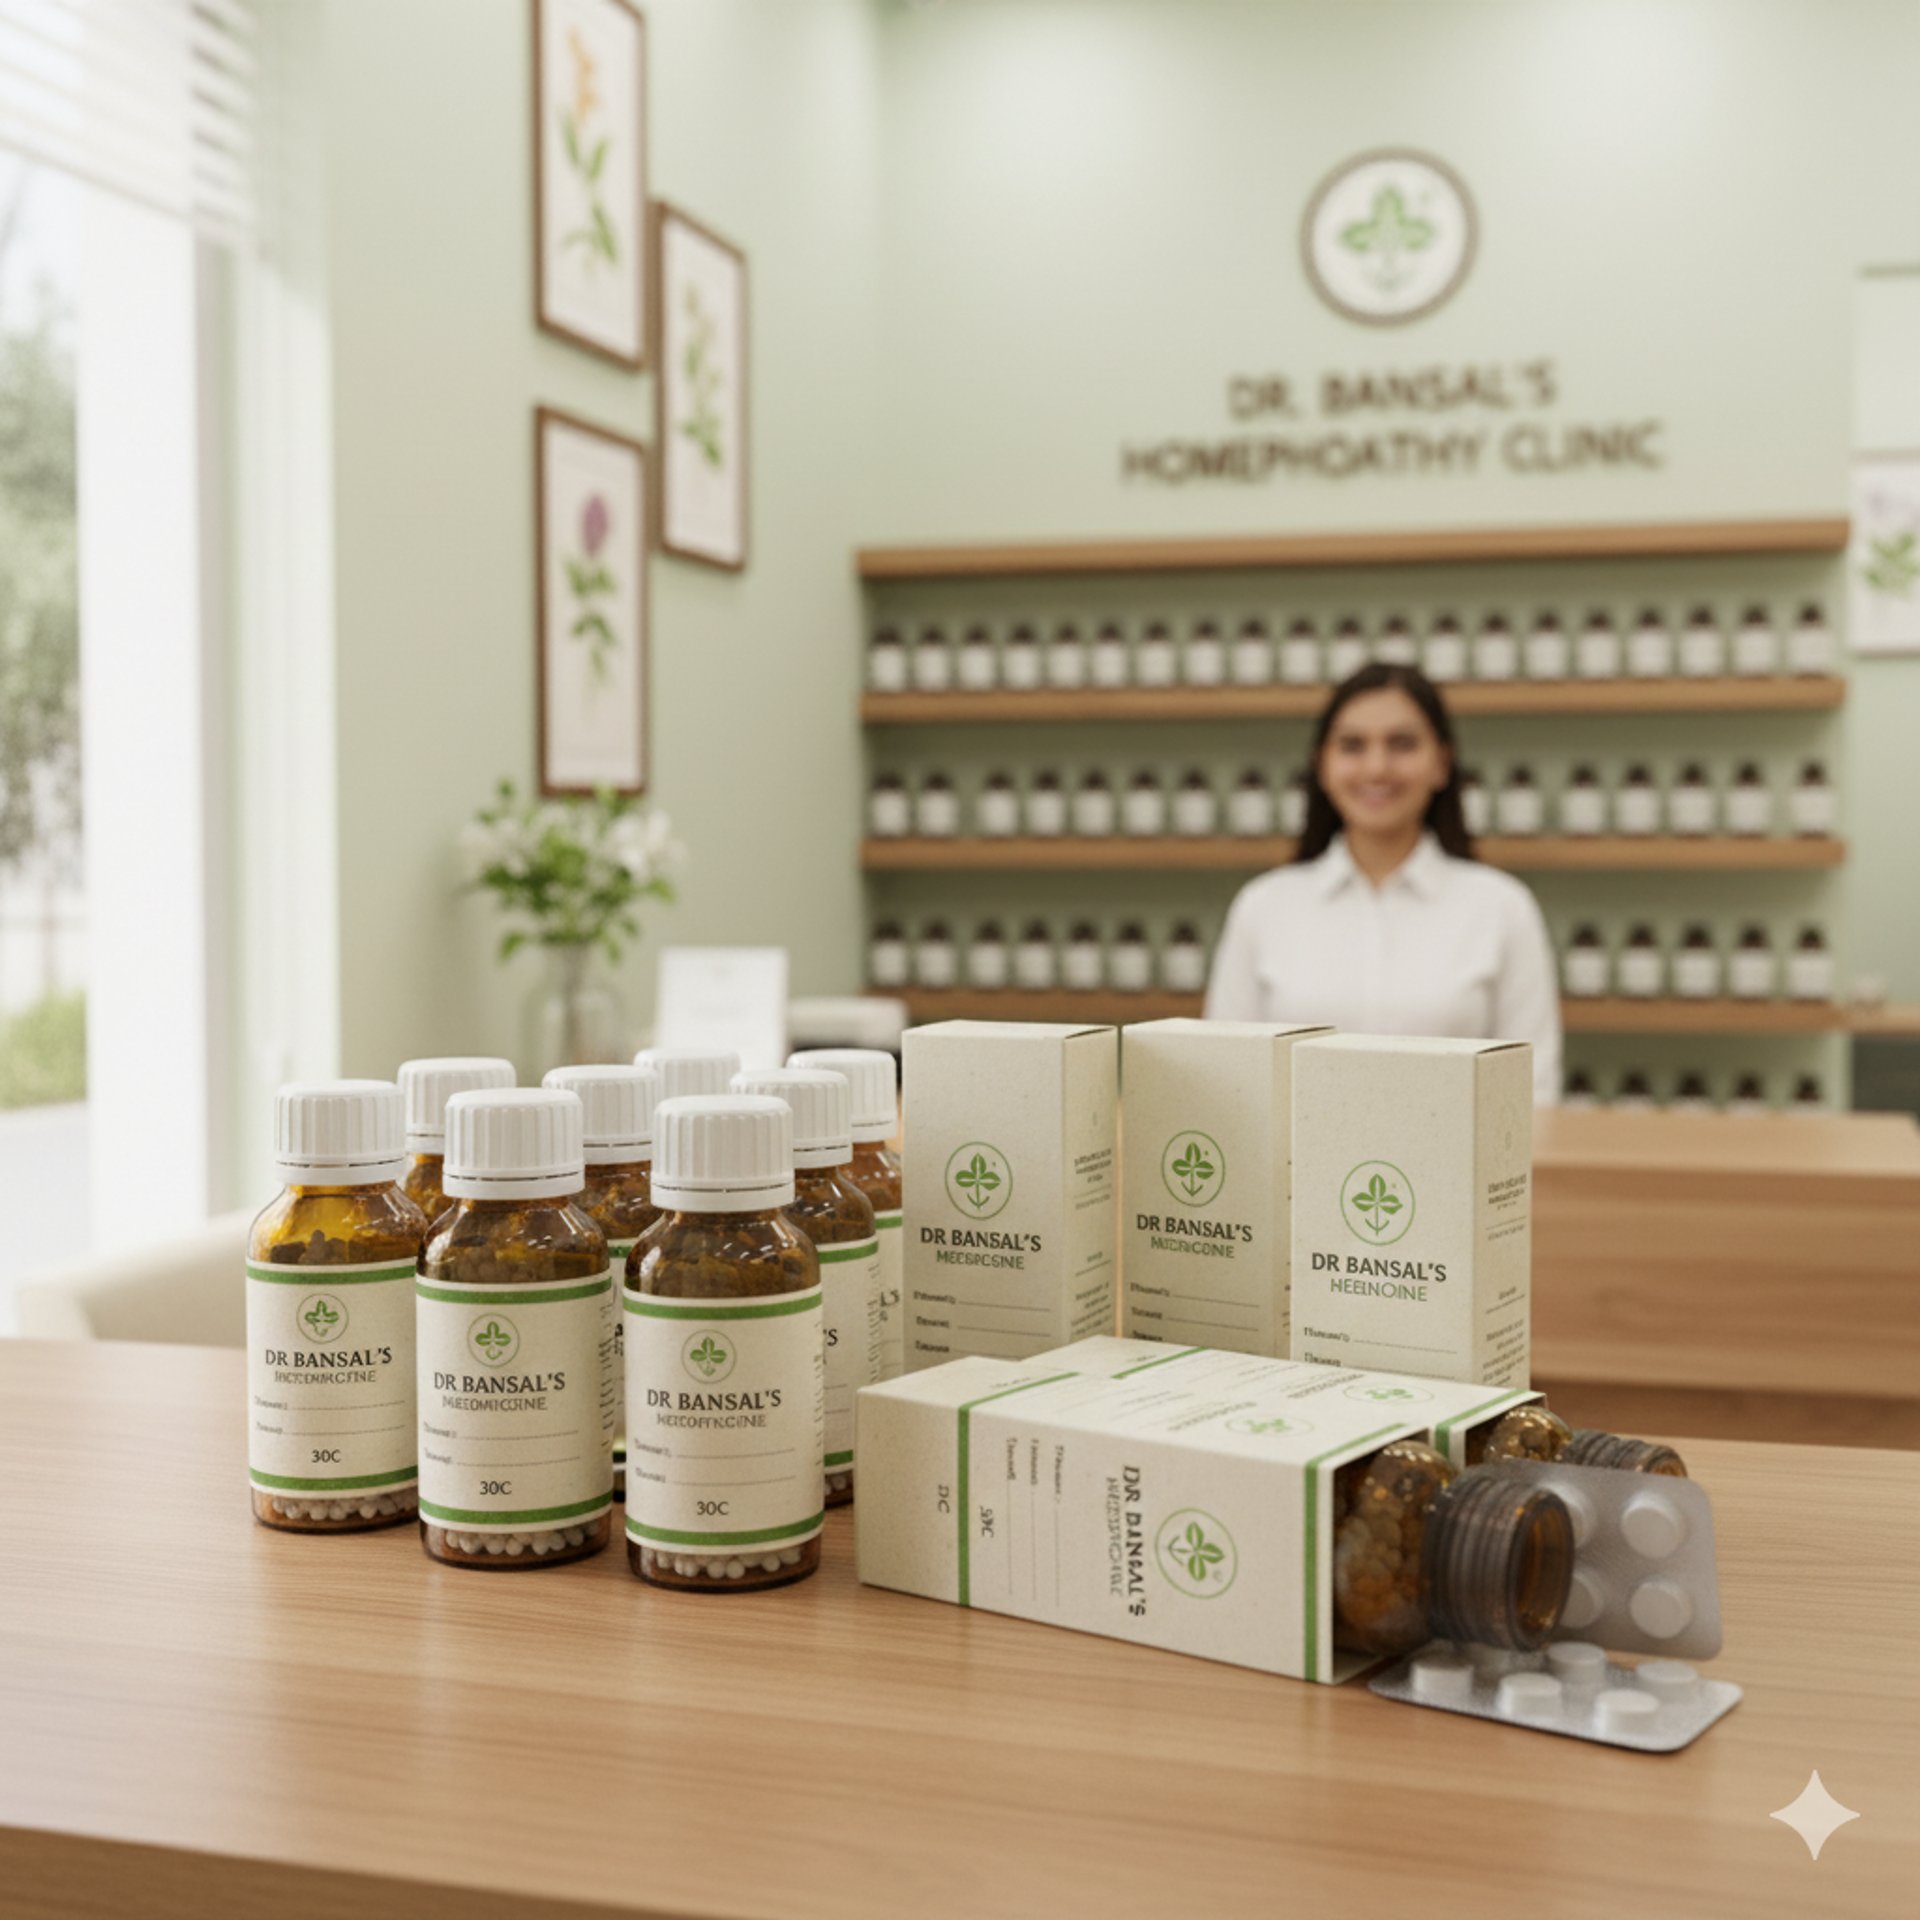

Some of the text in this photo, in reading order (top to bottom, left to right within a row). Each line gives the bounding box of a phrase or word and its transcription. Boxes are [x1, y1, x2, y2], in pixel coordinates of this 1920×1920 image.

[1227, 360, 1557, 420] DR. BANSAL'S
[1502, 418, 1664, 474] CLINIC
[1137, 1214, 1253, 1242] DR BANSAL'S
[920, 1227, 1042, 1252] DR BANSAL'S
[1312, 1252, 1447, 1282] DR BANSAL'S
[266, 1346, 393, 1368] DR BANSAL'S
[434, 1372, 566, 1394] DR BANSAL'S
[647, 1389, 782, 1411] DR BANSAL'S
[312, 1450, 341, 1464] 30C
[480, 1481, 513, 1496] 30C
[697, 1501, 730, 1516] 30C
